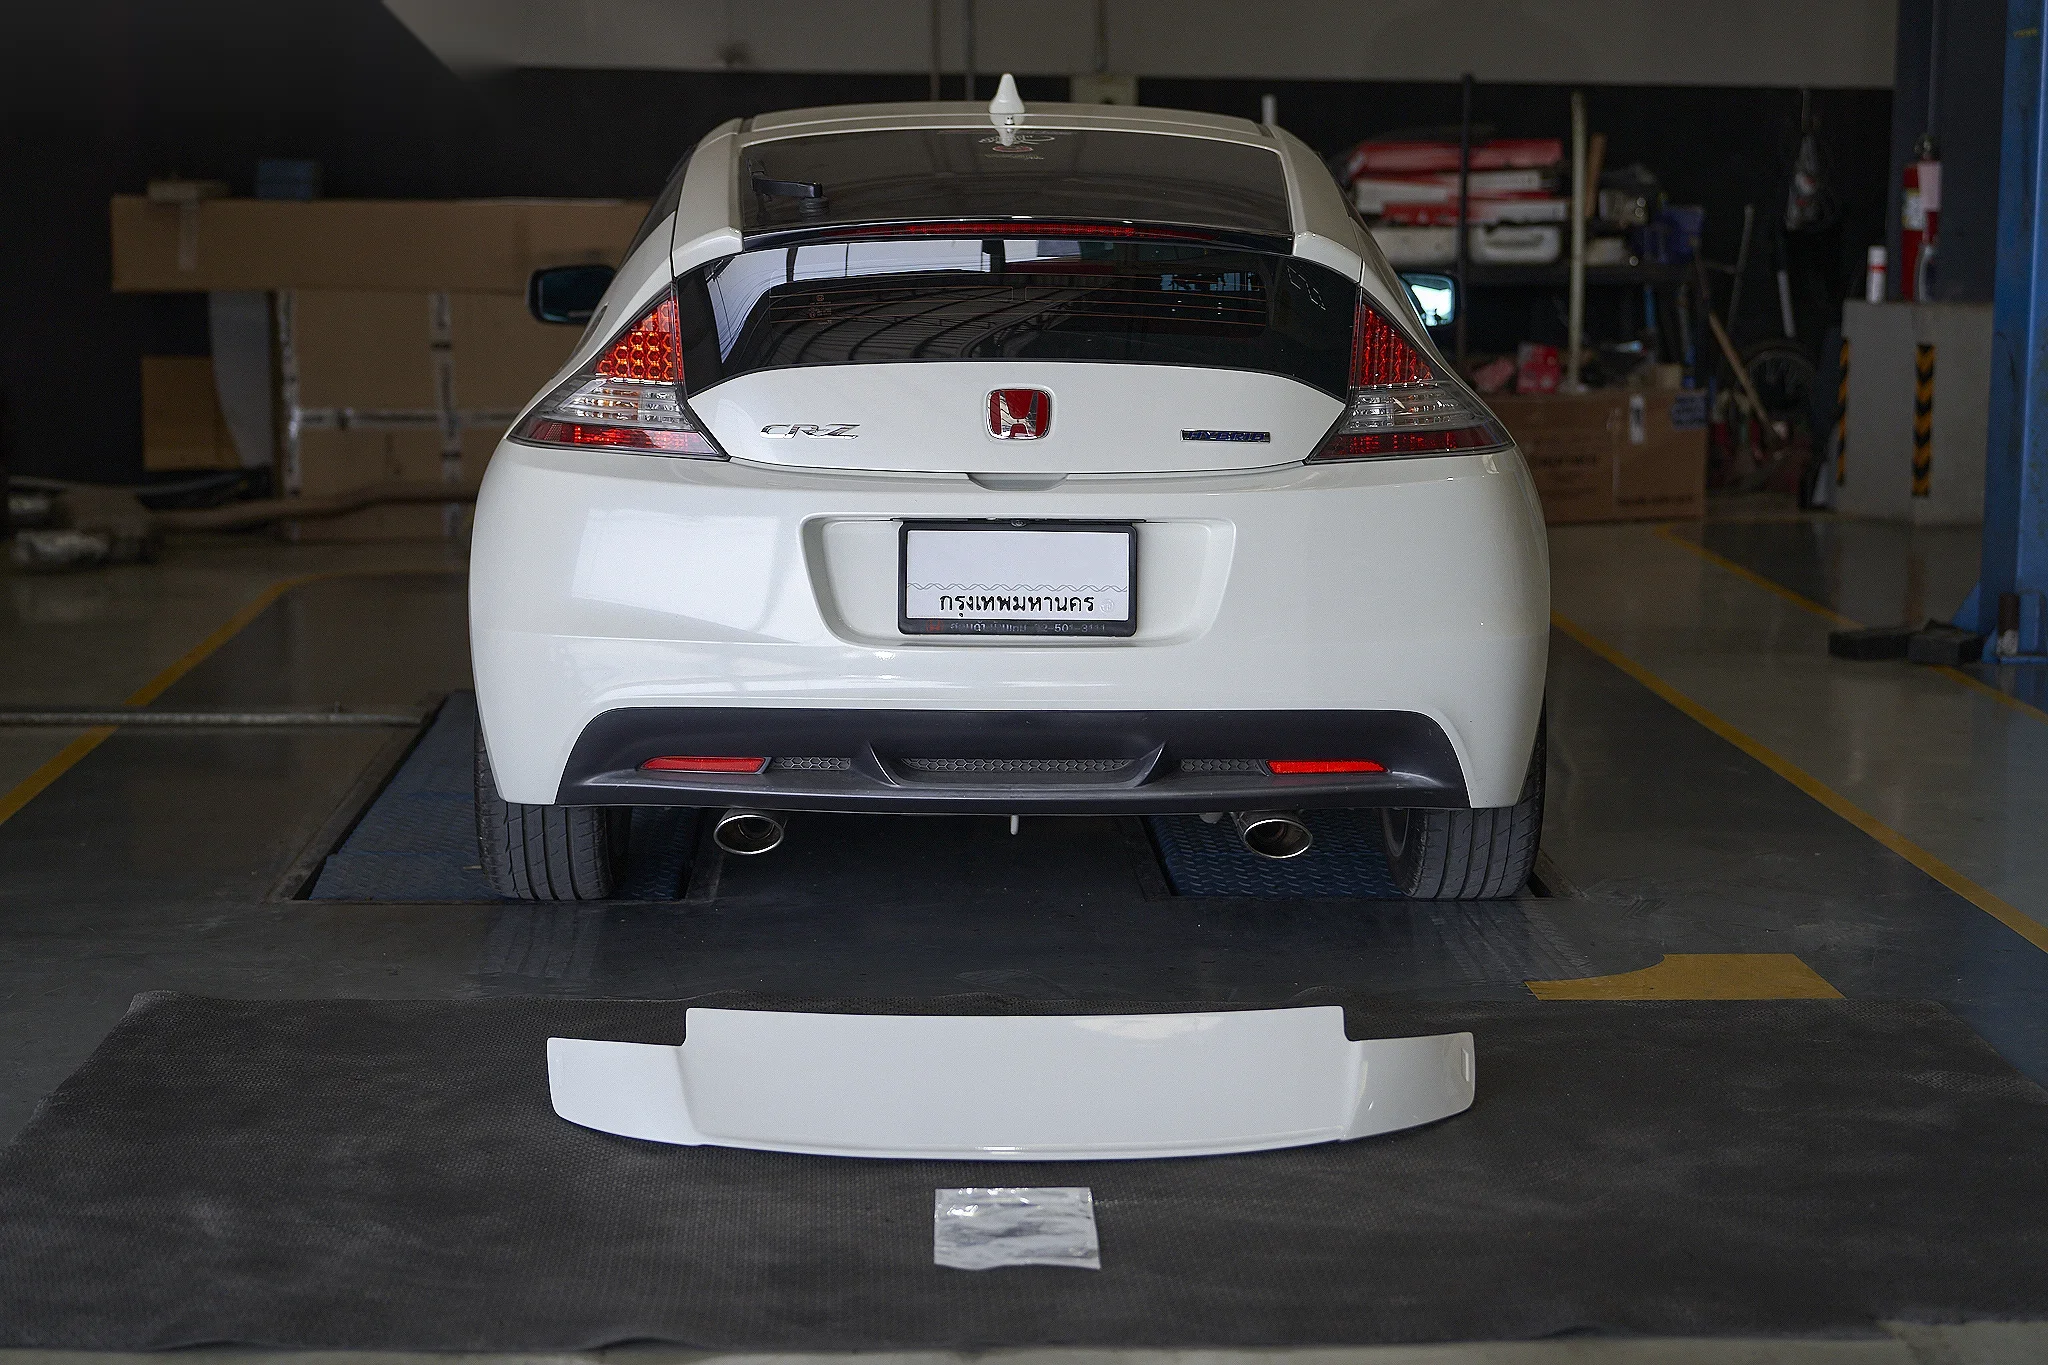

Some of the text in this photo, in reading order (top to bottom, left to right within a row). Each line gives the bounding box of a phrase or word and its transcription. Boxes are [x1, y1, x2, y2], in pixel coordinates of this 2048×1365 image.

[760, 423, 860, 440] CR-Z
[939, 595, 1094, 618] กรุงเทพมหานคร
